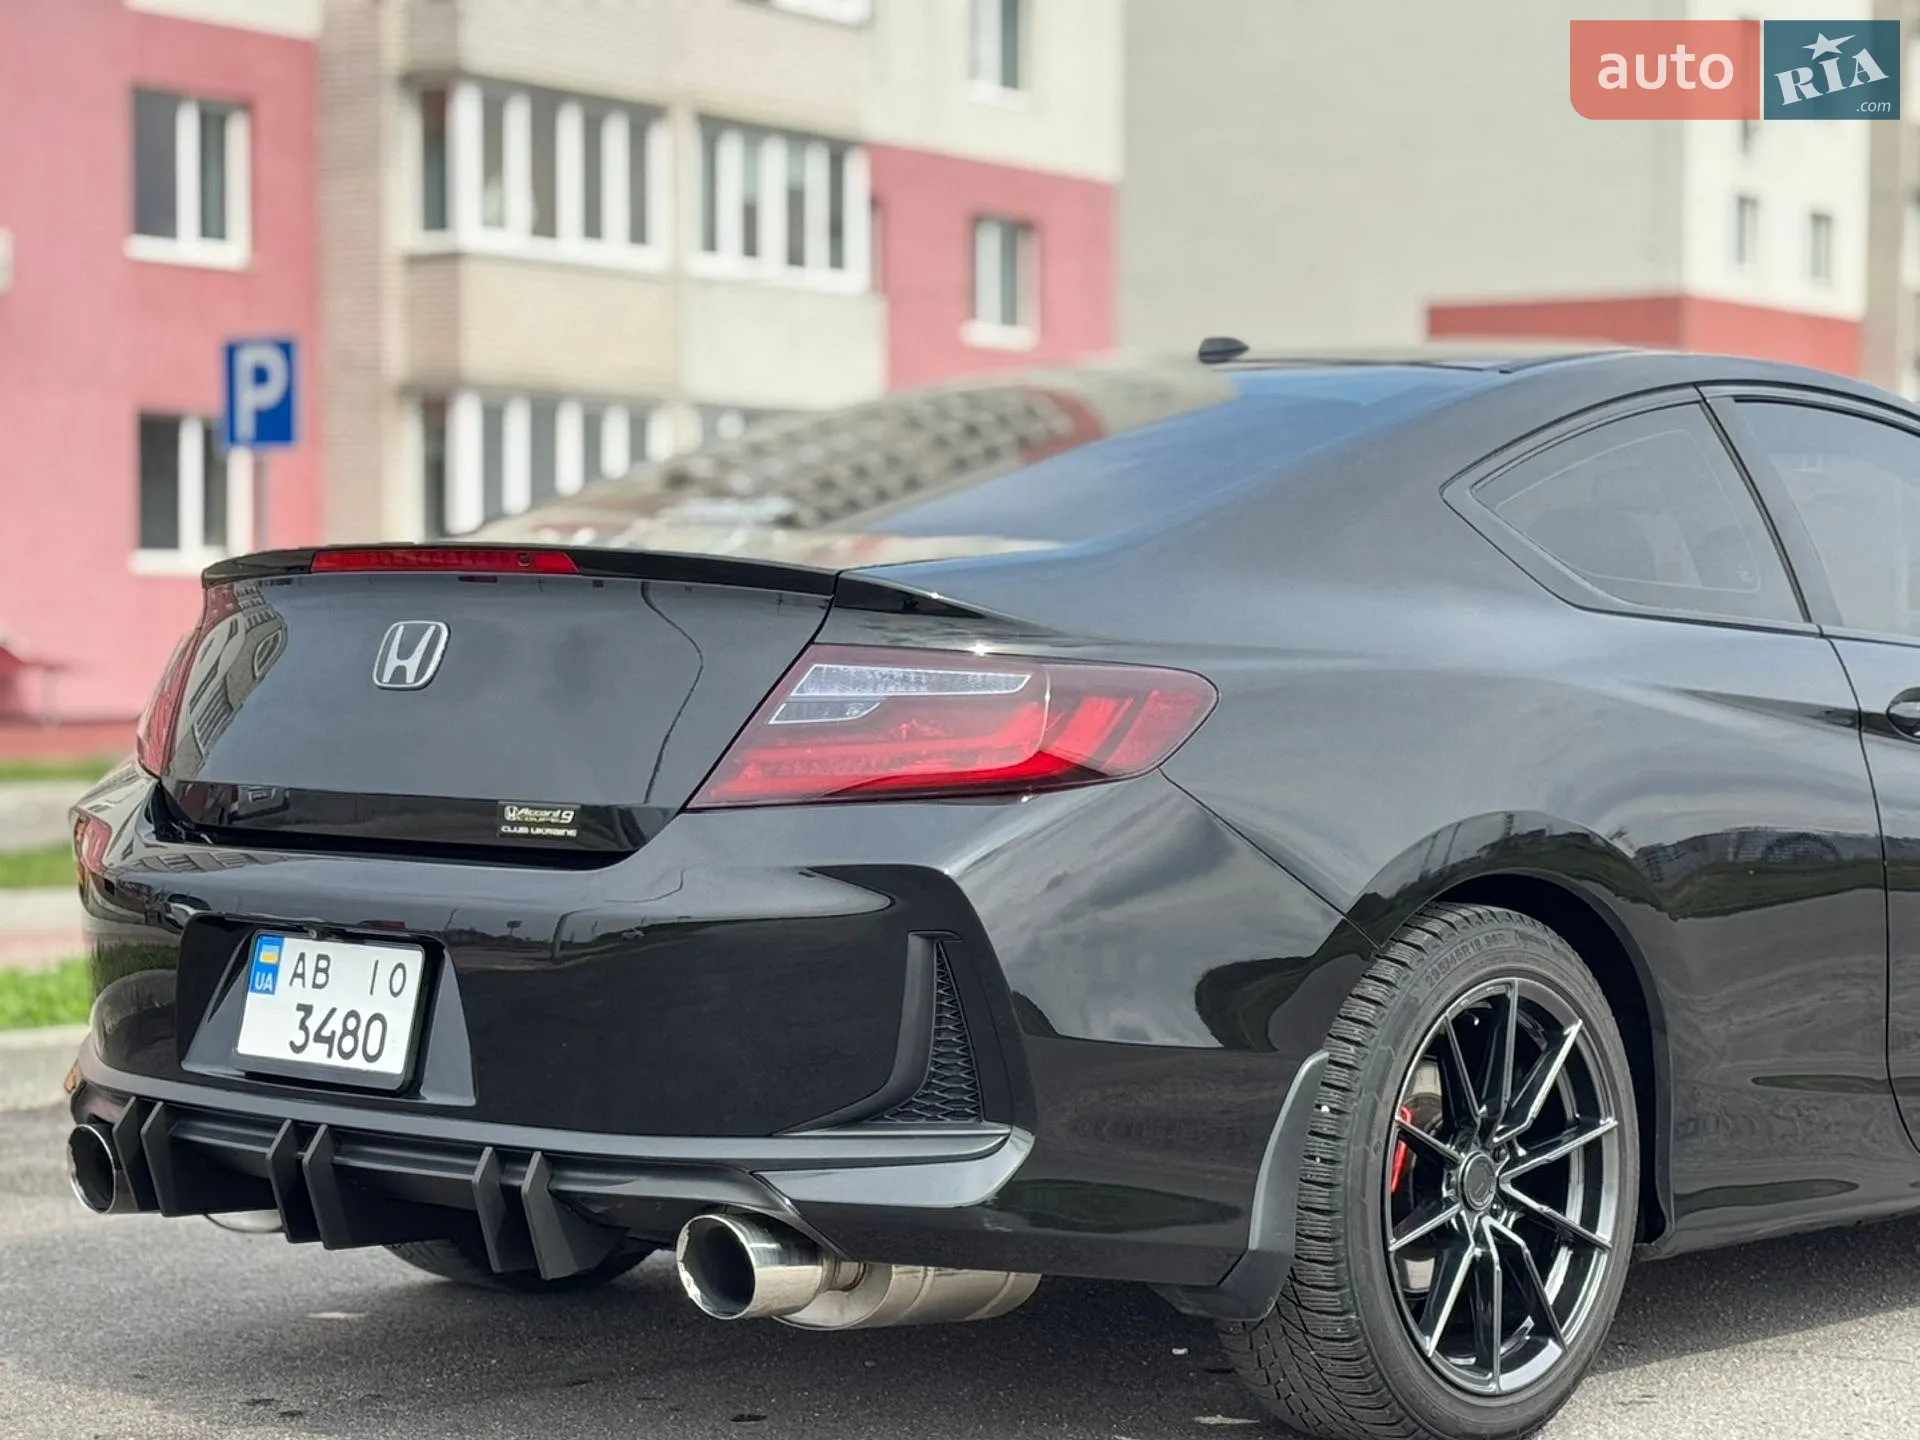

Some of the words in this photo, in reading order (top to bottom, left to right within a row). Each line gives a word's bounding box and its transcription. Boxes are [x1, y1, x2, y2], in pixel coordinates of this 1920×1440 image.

[234, 344, 289, 441] P
[501, 825, 529, 834] CLUB
[254, 972, 274, 991] UA
[289, 952, 331, 990] AB
[289, 1003, 388, 1063] 3480
